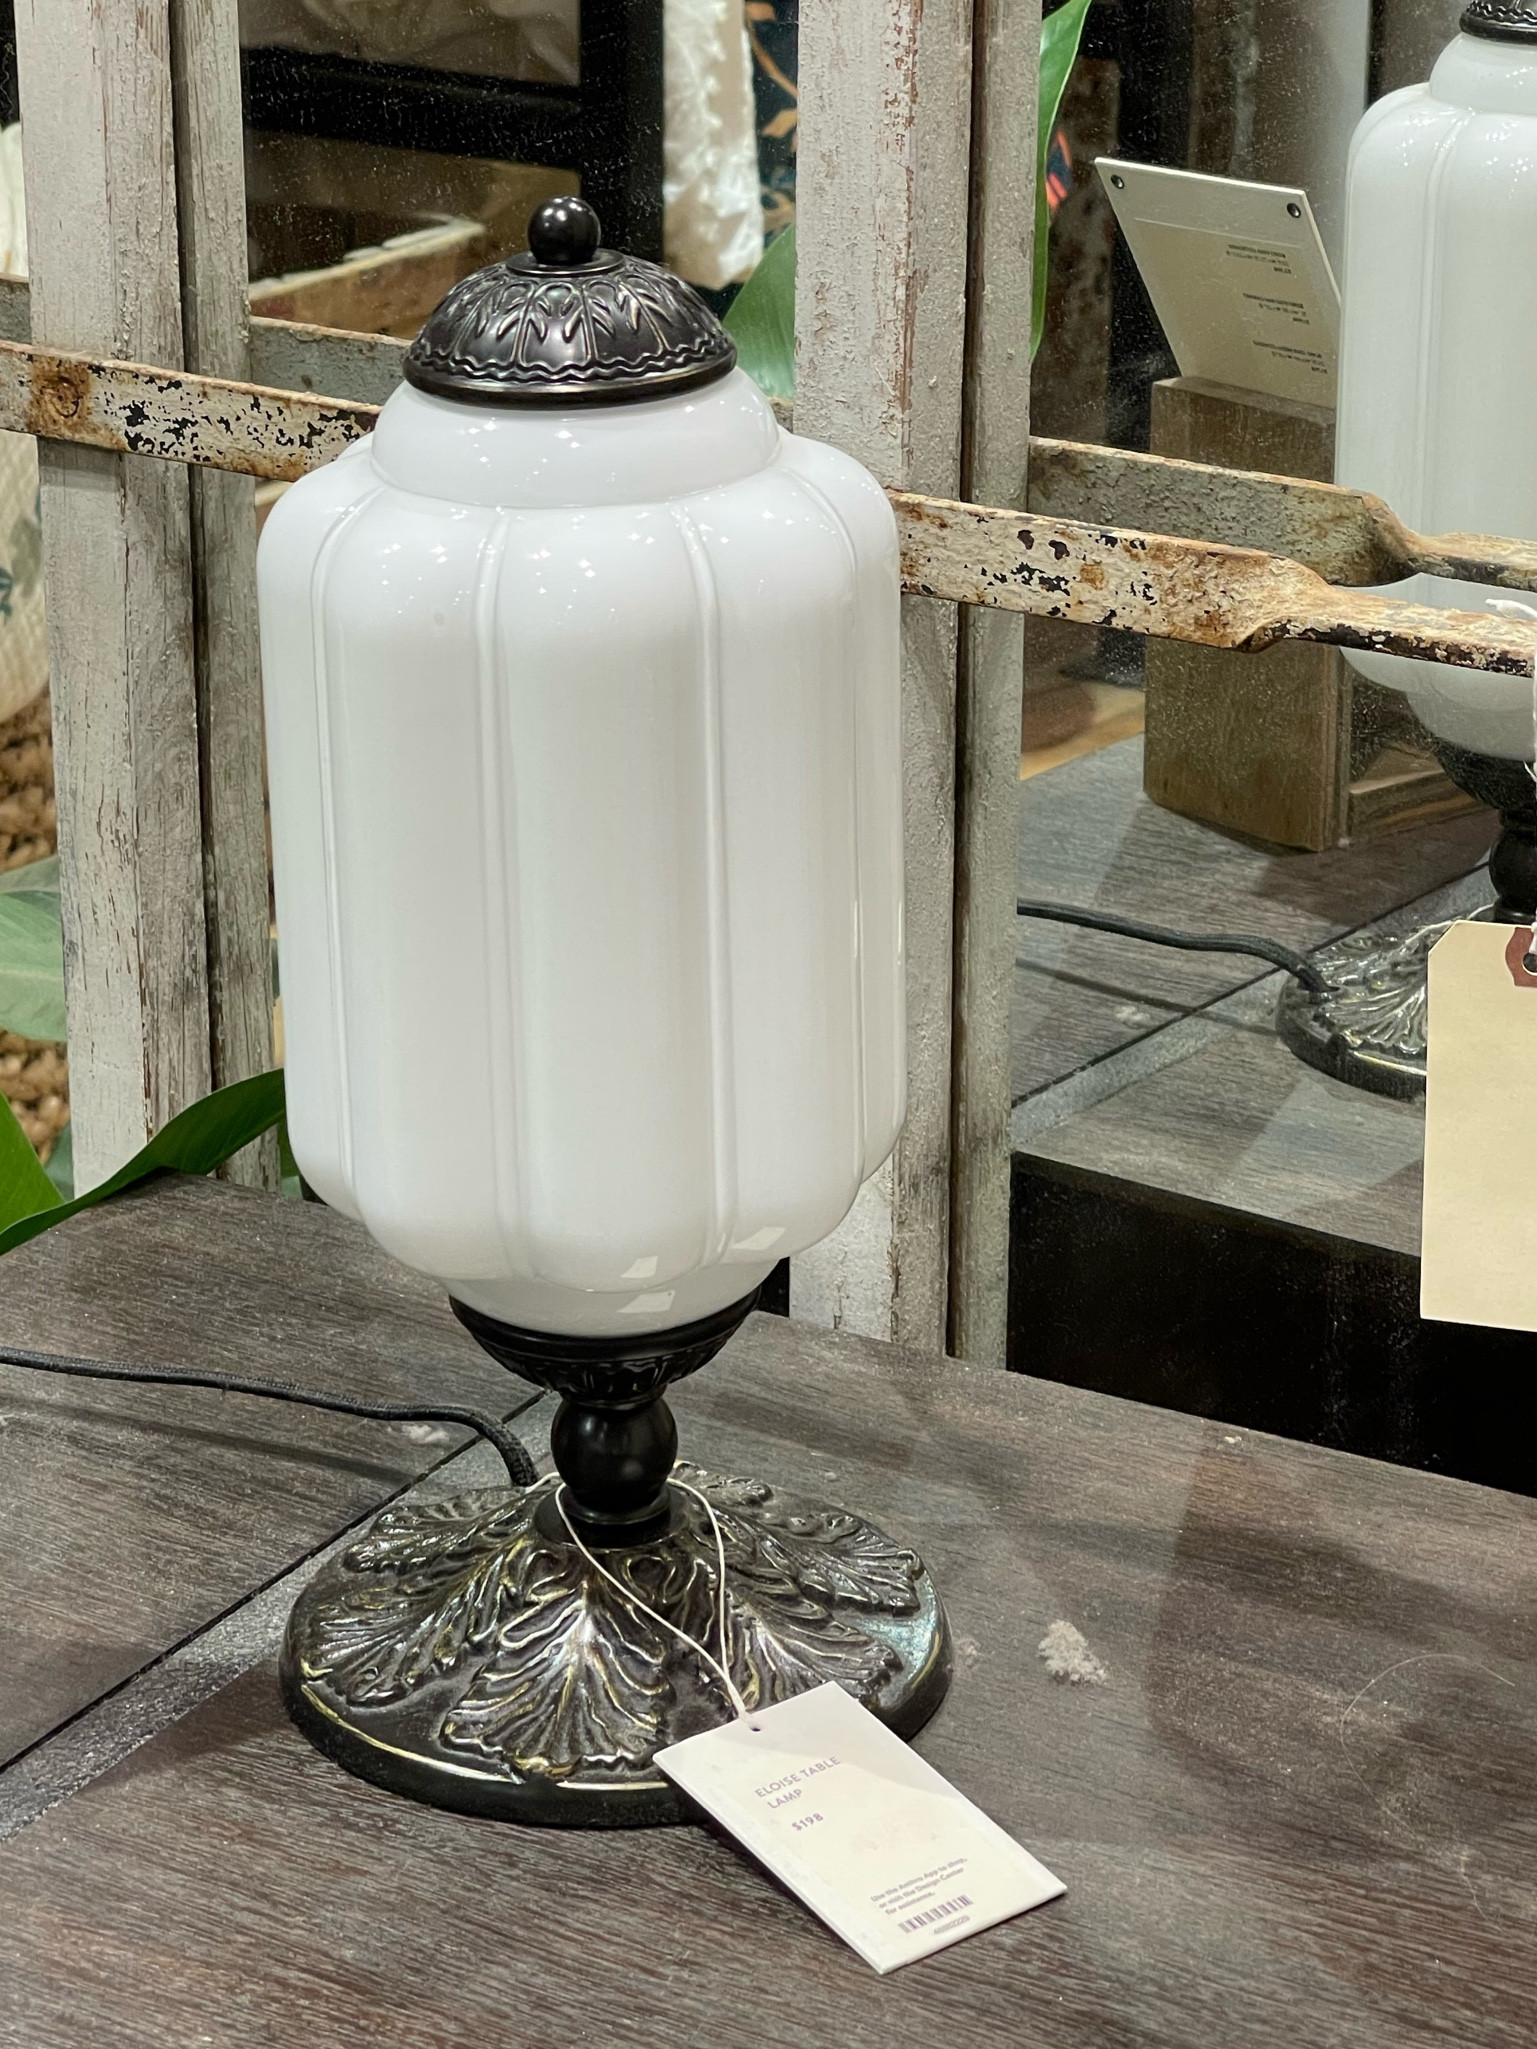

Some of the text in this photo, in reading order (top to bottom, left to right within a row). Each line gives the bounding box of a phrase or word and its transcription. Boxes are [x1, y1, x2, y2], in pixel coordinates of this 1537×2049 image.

[755, 1756, 842, 1797] ELOISE TABLE
[767, 1788, 802, 1809] LAMP
[791, 1813, 824, 1831] $198
